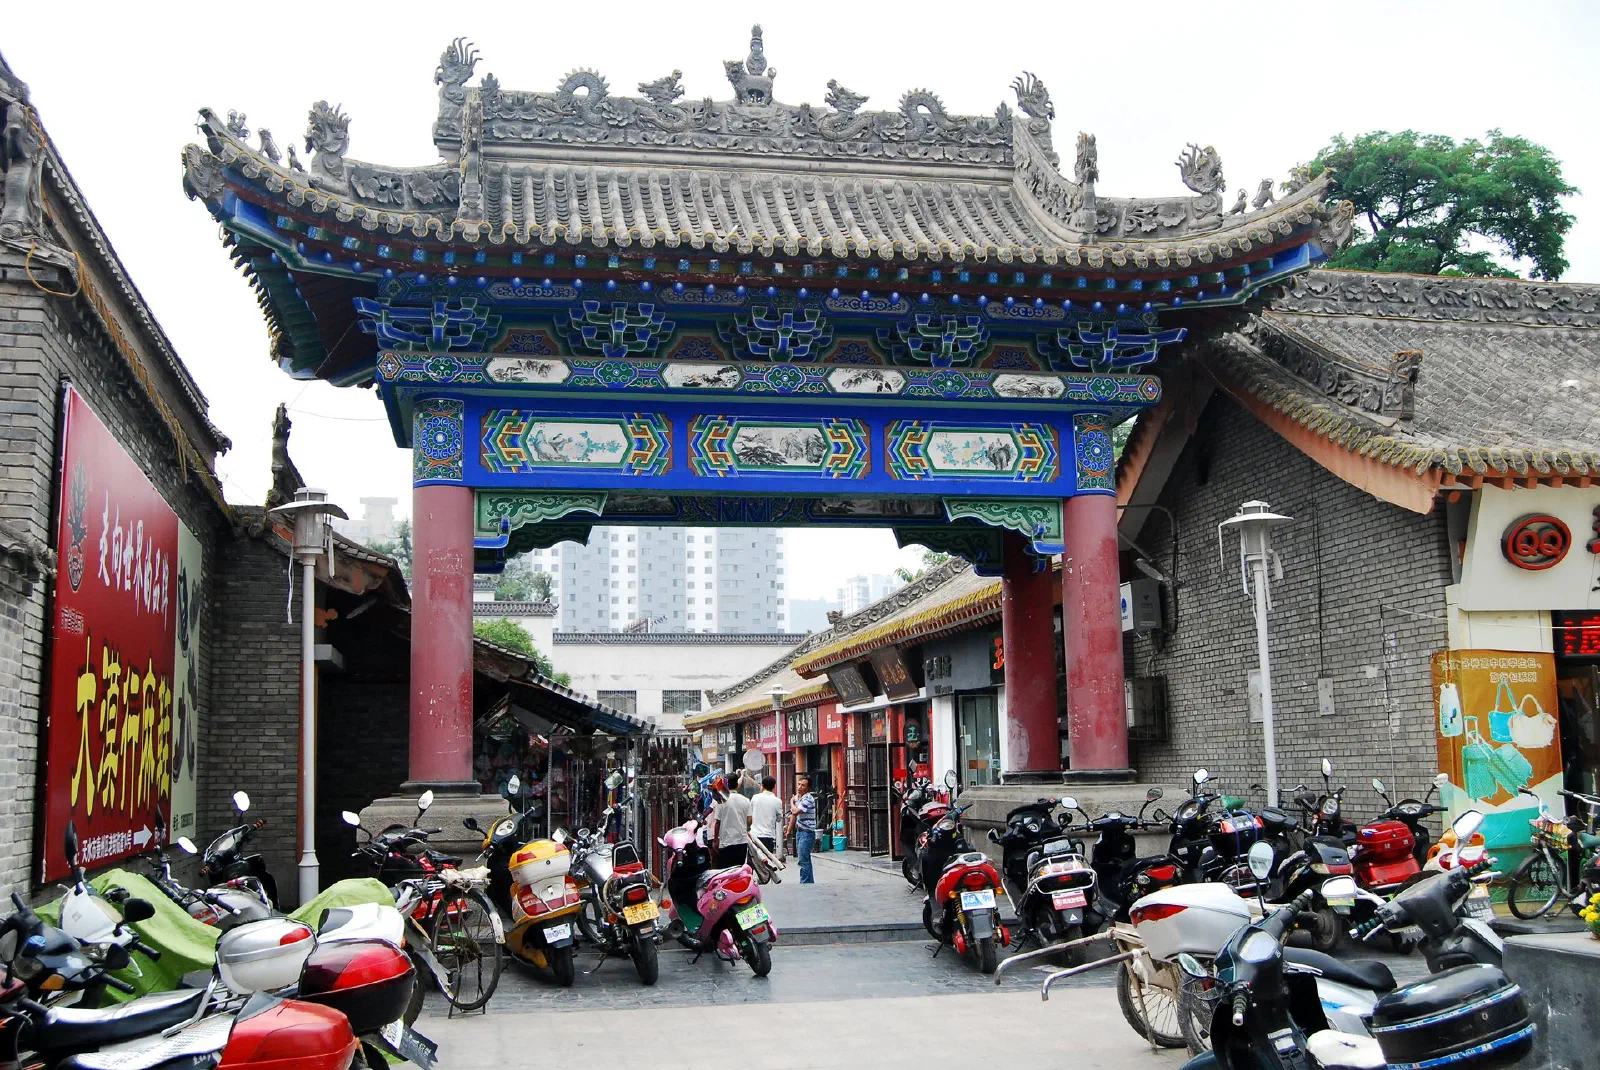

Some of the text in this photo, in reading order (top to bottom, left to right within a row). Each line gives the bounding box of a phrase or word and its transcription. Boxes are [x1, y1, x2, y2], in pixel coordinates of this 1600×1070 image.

[1516, 529, 1563, 557] QQ
[71, 636, 170, 819] 大漠行麻鞋
